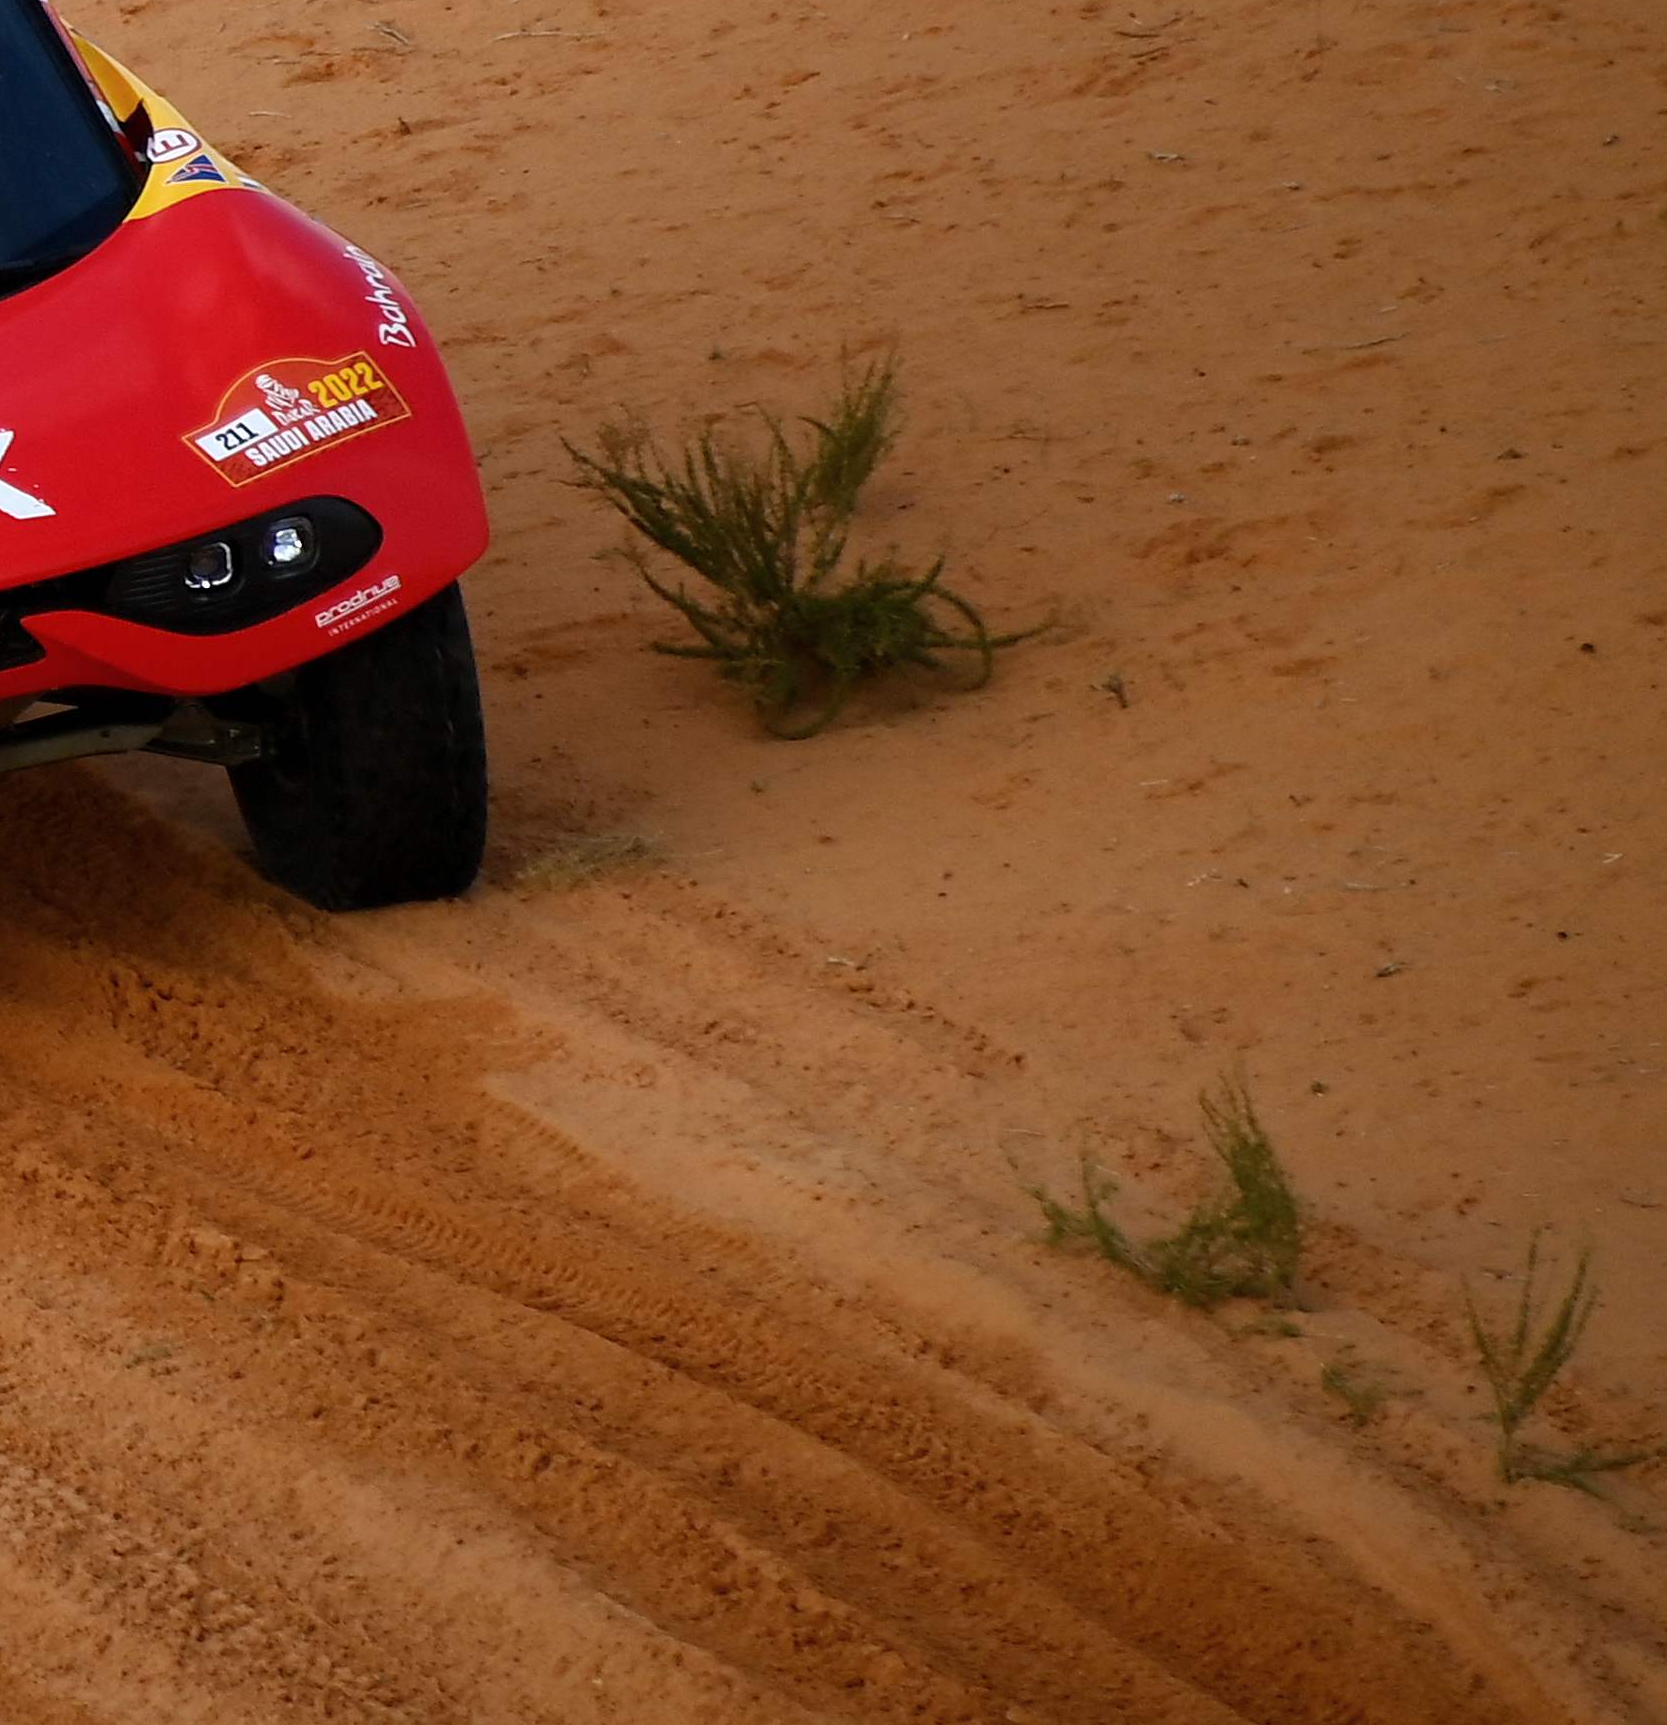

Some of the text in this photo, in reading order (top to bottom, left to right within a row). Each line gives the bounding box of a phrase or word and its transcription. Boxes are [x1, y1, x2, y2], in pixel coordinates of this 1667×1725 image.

[342, 244, 417, 348] Bahrain
[307, 361, 386, 410] 2022
[215, 422, 259, 451] 211
[244, 398, 379, 467] SAUDI ARABIA
[270, 397, 322, 427] DAKAR
[314, 574, 400, 629] prodrive
[327, 597, 399, 637] INTERNATIONAL
